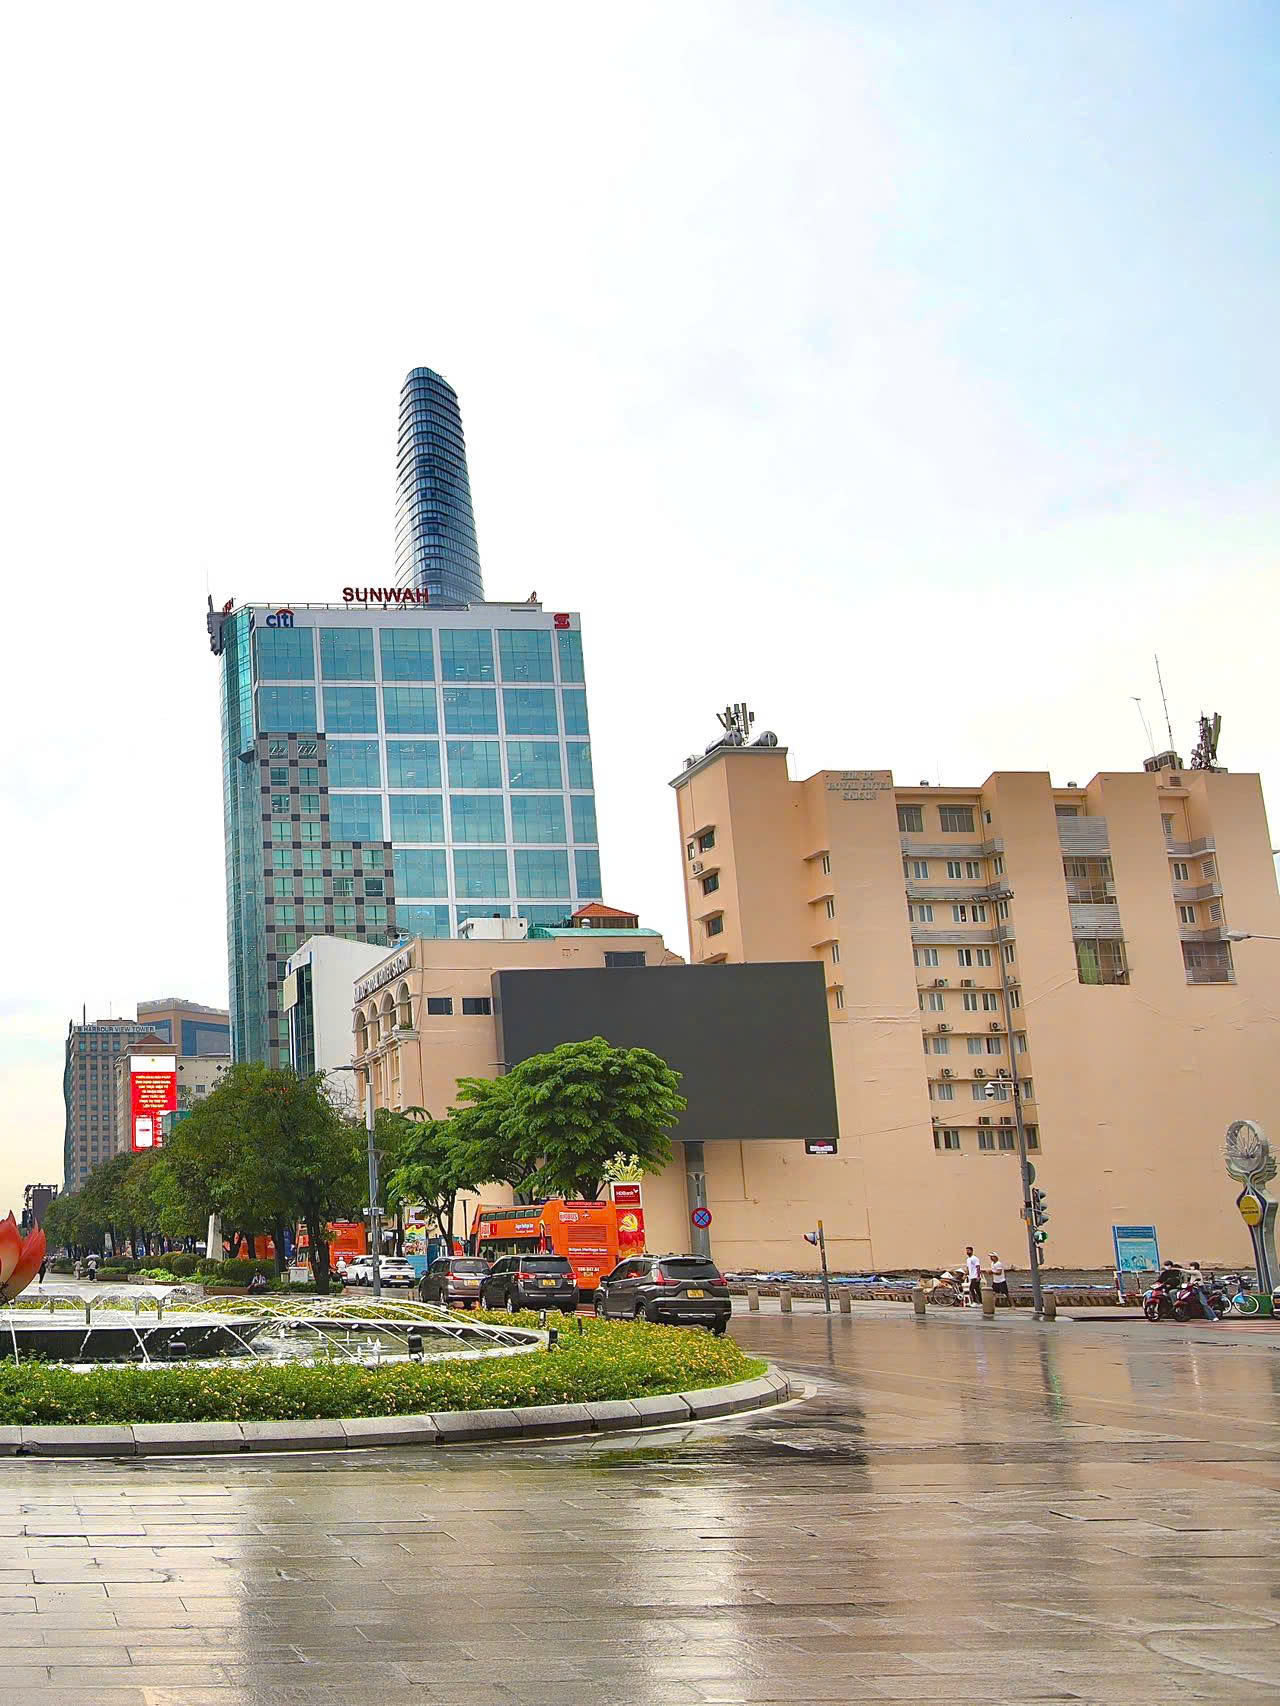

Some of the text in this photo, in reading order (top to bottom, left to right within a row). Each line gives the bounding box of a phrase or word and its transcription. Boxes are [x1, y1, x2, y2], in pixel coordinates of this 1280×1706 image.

[342, 587, 429, 603] SUNWAH
[265, 611, 294, 628] citi
[843, 791, 877, 801] SAIGON
